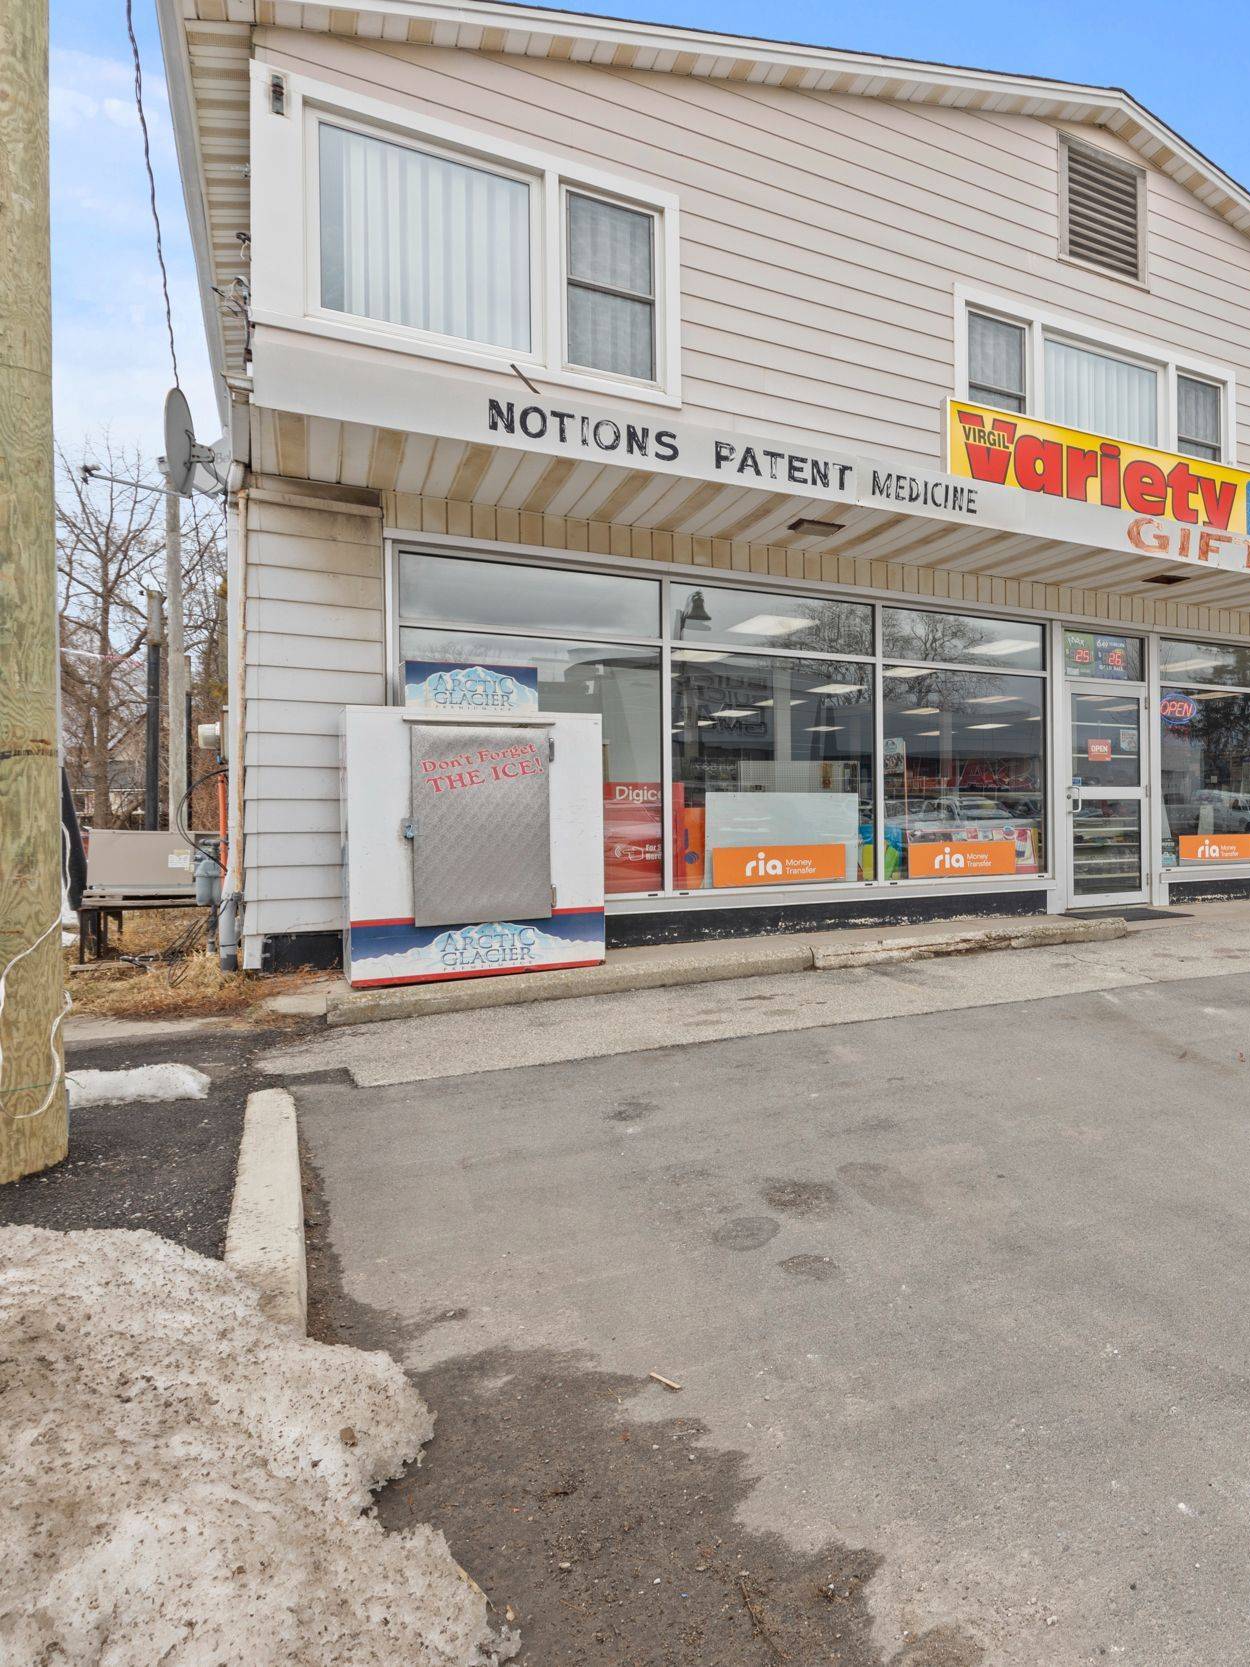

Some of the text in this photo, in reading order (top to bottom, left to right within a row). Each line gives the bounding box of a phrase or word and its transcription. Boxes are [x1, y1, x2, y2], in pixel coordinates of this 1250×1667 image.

[962, 425, 1010, 450] VIRGIL
[488, 398, 979, 514] NOTIONS PATENT MEDICINE
[957, 410, 1237, 530] Variety
[433, 674, 514, 694] ARCTIC
[433, 691, 514, 707] GLACIER
[1161, 700, 1193, 717] OPEN
[421, 743, 537, 772] Don't Forget
[1090, 744, 1108, 753] OPEN
[426, 757, 545, 793] THE ICE!
[934, 847, 965, 868] ria
[966, 853, 989, 861] Money
[1197, 839, 1219, 858] ria
[745, 851, 783, 876] ria
[785, 858, 812, 868] Money
[785, 865, 817, 875] Transfer
[967, 860, 992, 868] Transfer
[440, 927, 536, 952] ARCTIC
[441, 946, 535, 966] GLACIER
